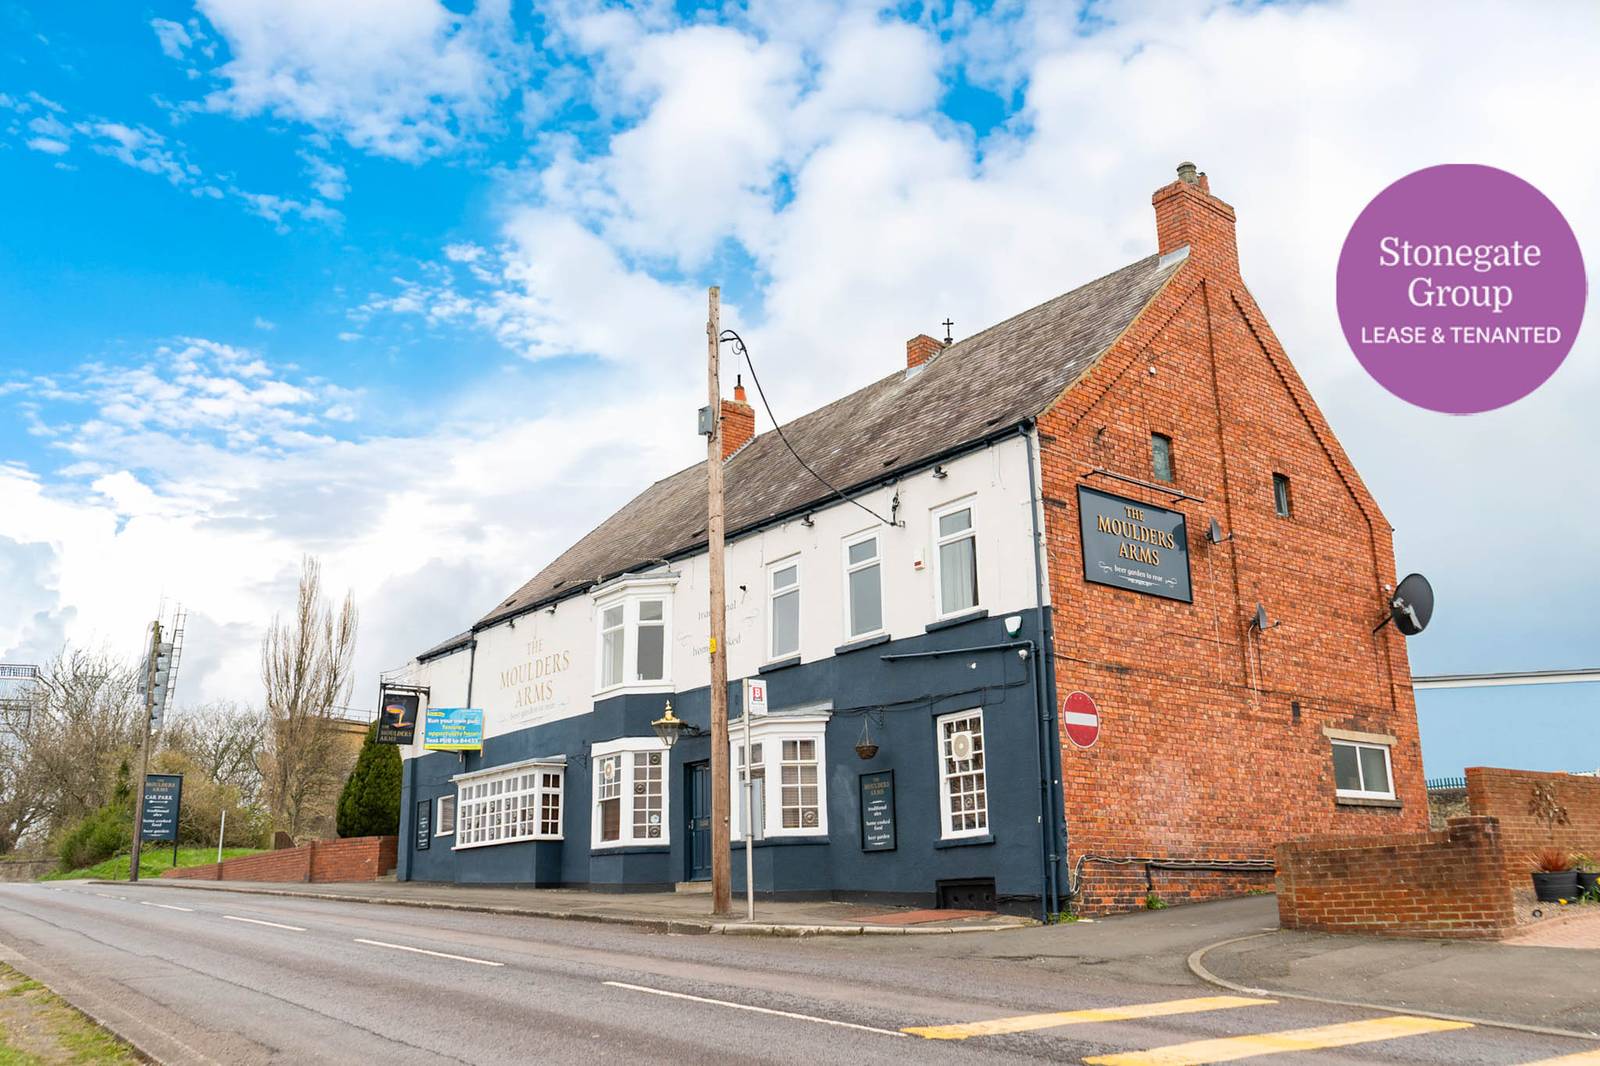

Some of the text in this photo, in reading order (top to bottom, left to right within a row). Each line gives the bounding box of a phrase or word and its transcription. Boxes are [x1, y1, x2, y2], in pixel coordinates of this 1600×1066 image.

[1124, 505, 1145, 522] THE
[1097, 513, 1175, 550] MOULDERS
[1119, 541, 1160, 567] ARMS
[1114, 564, 1127, 574] beer
[1127, 569, 1146, 578] garden
[1146, 572, 1152, 580] to
[528, 639, 543, 655] THE
[500, 649, 570, 690] MOULDERS
[514, 679, 554, 709] ARMS
